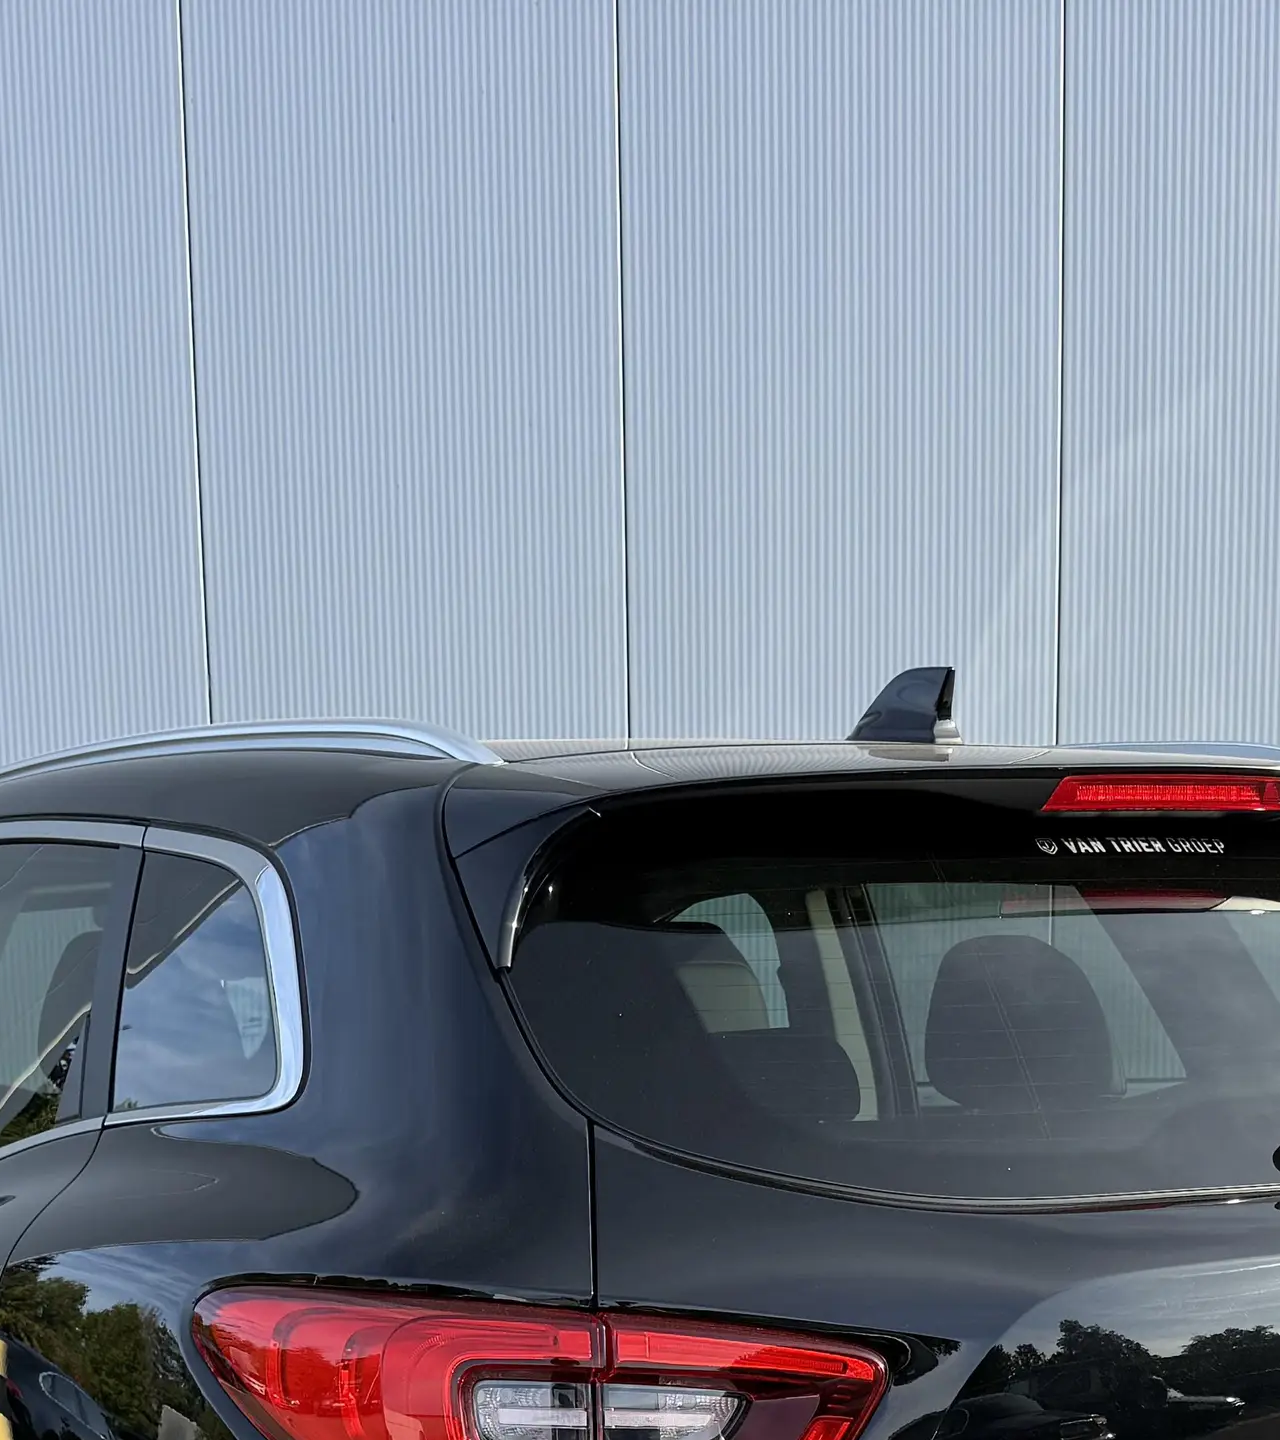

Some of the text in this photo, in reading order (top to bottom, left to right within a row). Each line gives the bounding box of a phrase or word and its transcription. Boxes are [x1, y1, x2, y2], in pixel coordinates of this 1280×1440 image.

[1060, 837, 1225, 854] VAN TRIER GROEP
